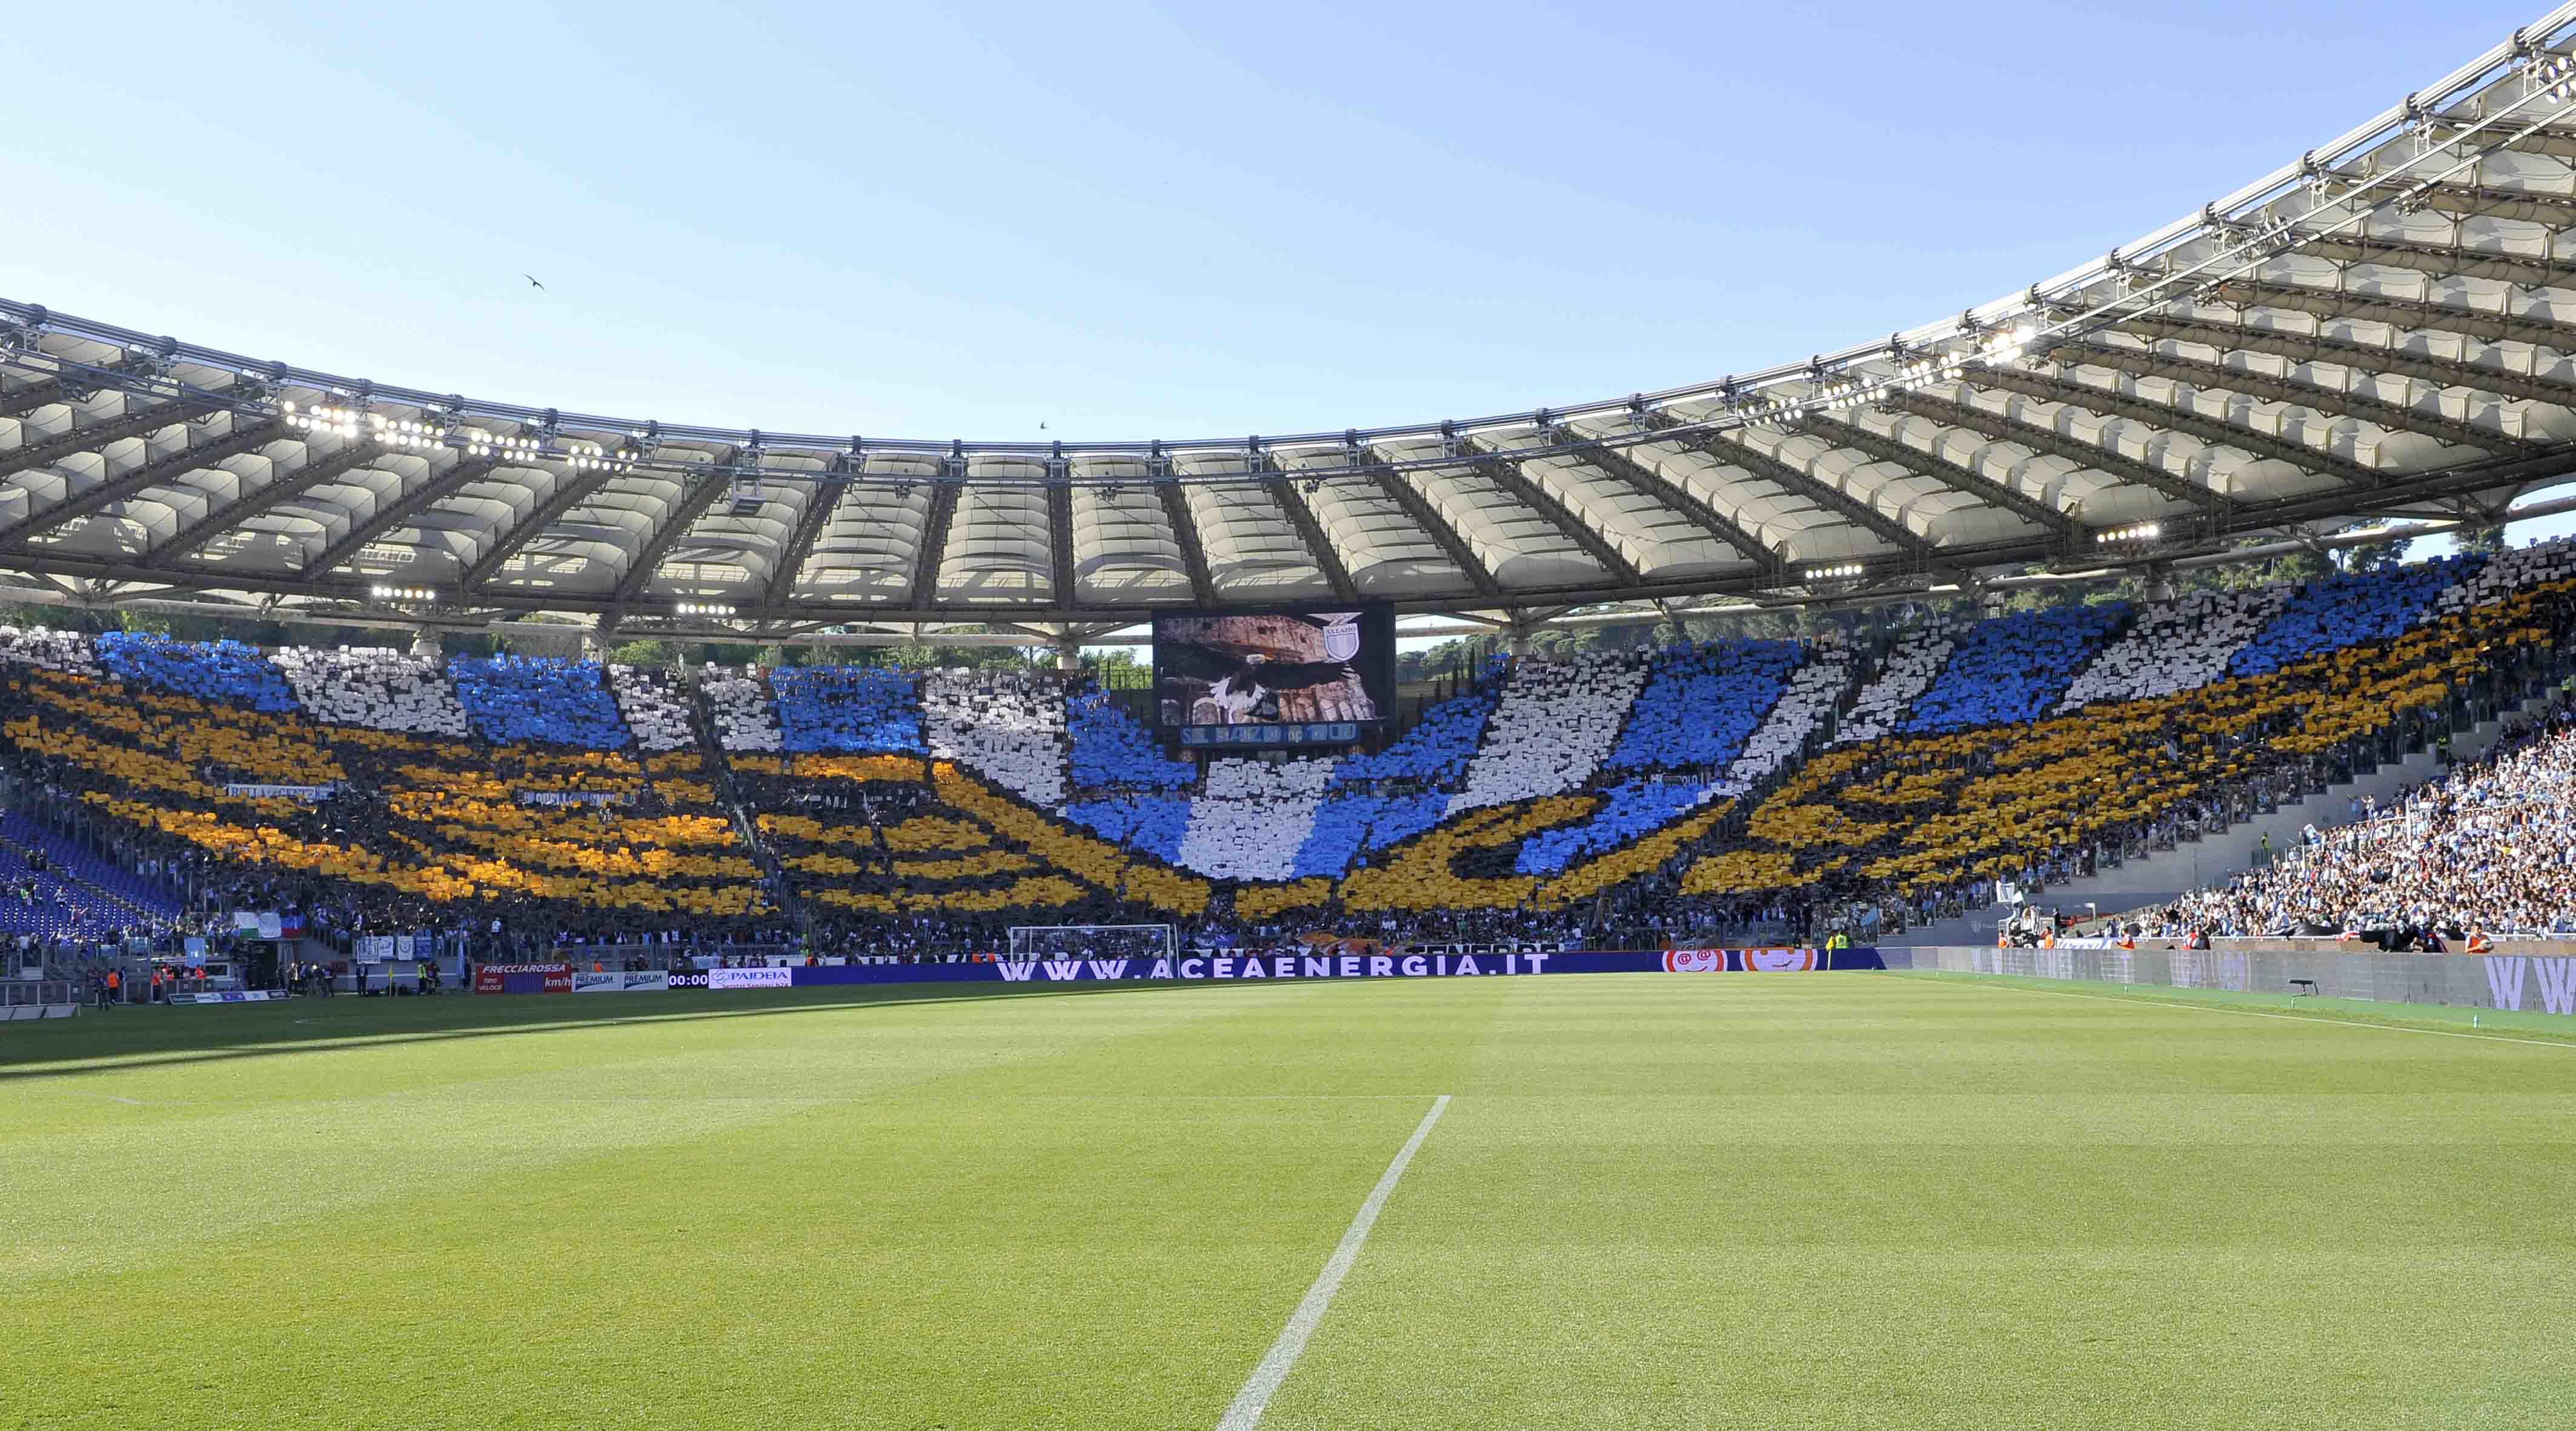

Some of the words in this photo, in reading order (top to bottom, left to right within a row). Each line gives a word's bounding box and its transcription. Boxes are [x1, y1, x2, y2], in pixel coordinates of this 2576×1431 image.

[482, 964, 566, 974] FRECCIAROSSA
[576, 974, 614, 984] PREMIUM
[625, 974, 663, 983] PREMIUM
[668, 975, 708, 986] 00:00
[731, 971, 788, 980] PAIDEIA
[545, 977, 571, 988] km/h
